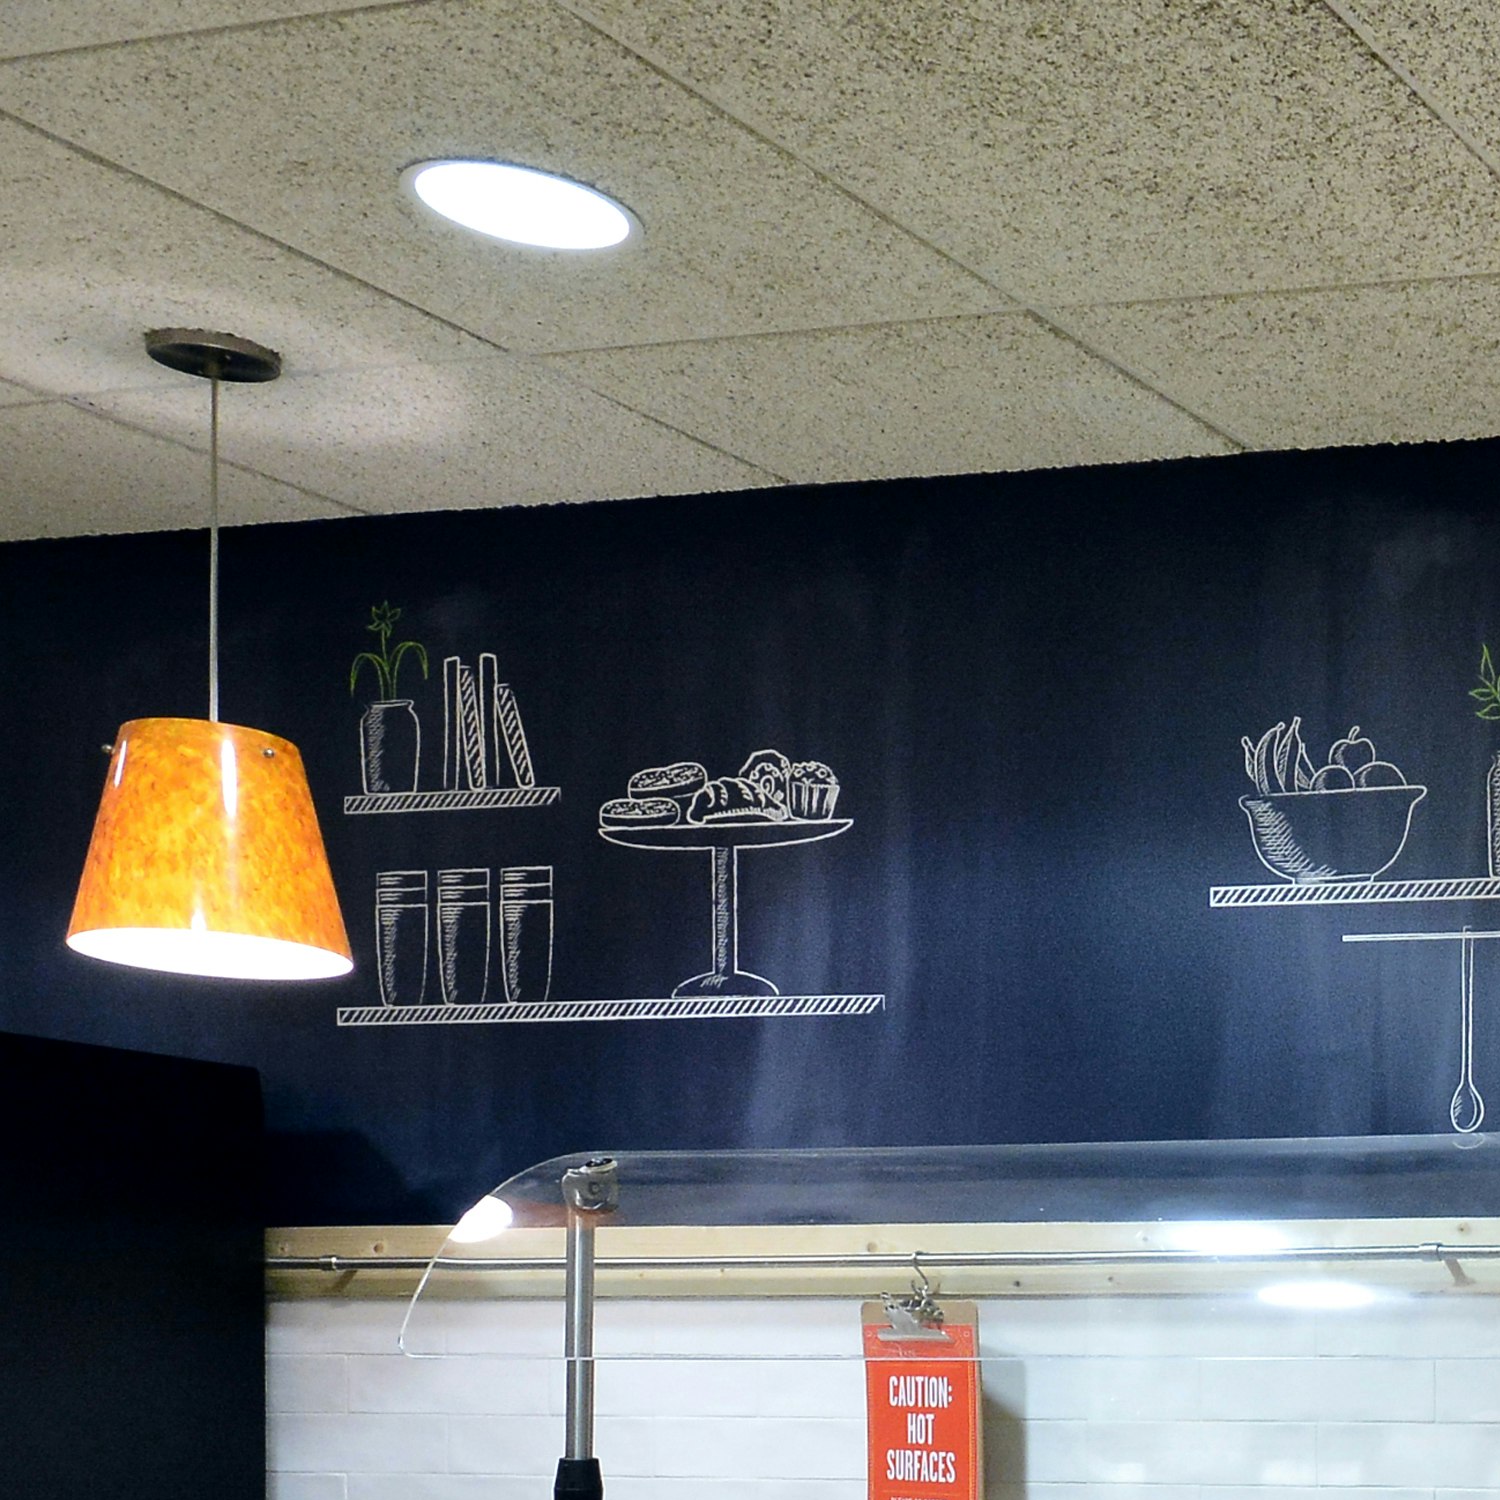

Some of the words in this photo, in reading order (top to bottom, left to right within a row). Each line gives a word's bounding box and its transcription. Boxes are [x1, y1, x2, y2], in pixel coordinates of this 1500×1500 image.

[889, 1375, 953, 1408] CAUTION:
[907, 1413, 936, 1445] HOT
[886, 1450, 956, 1483] SURFACES
